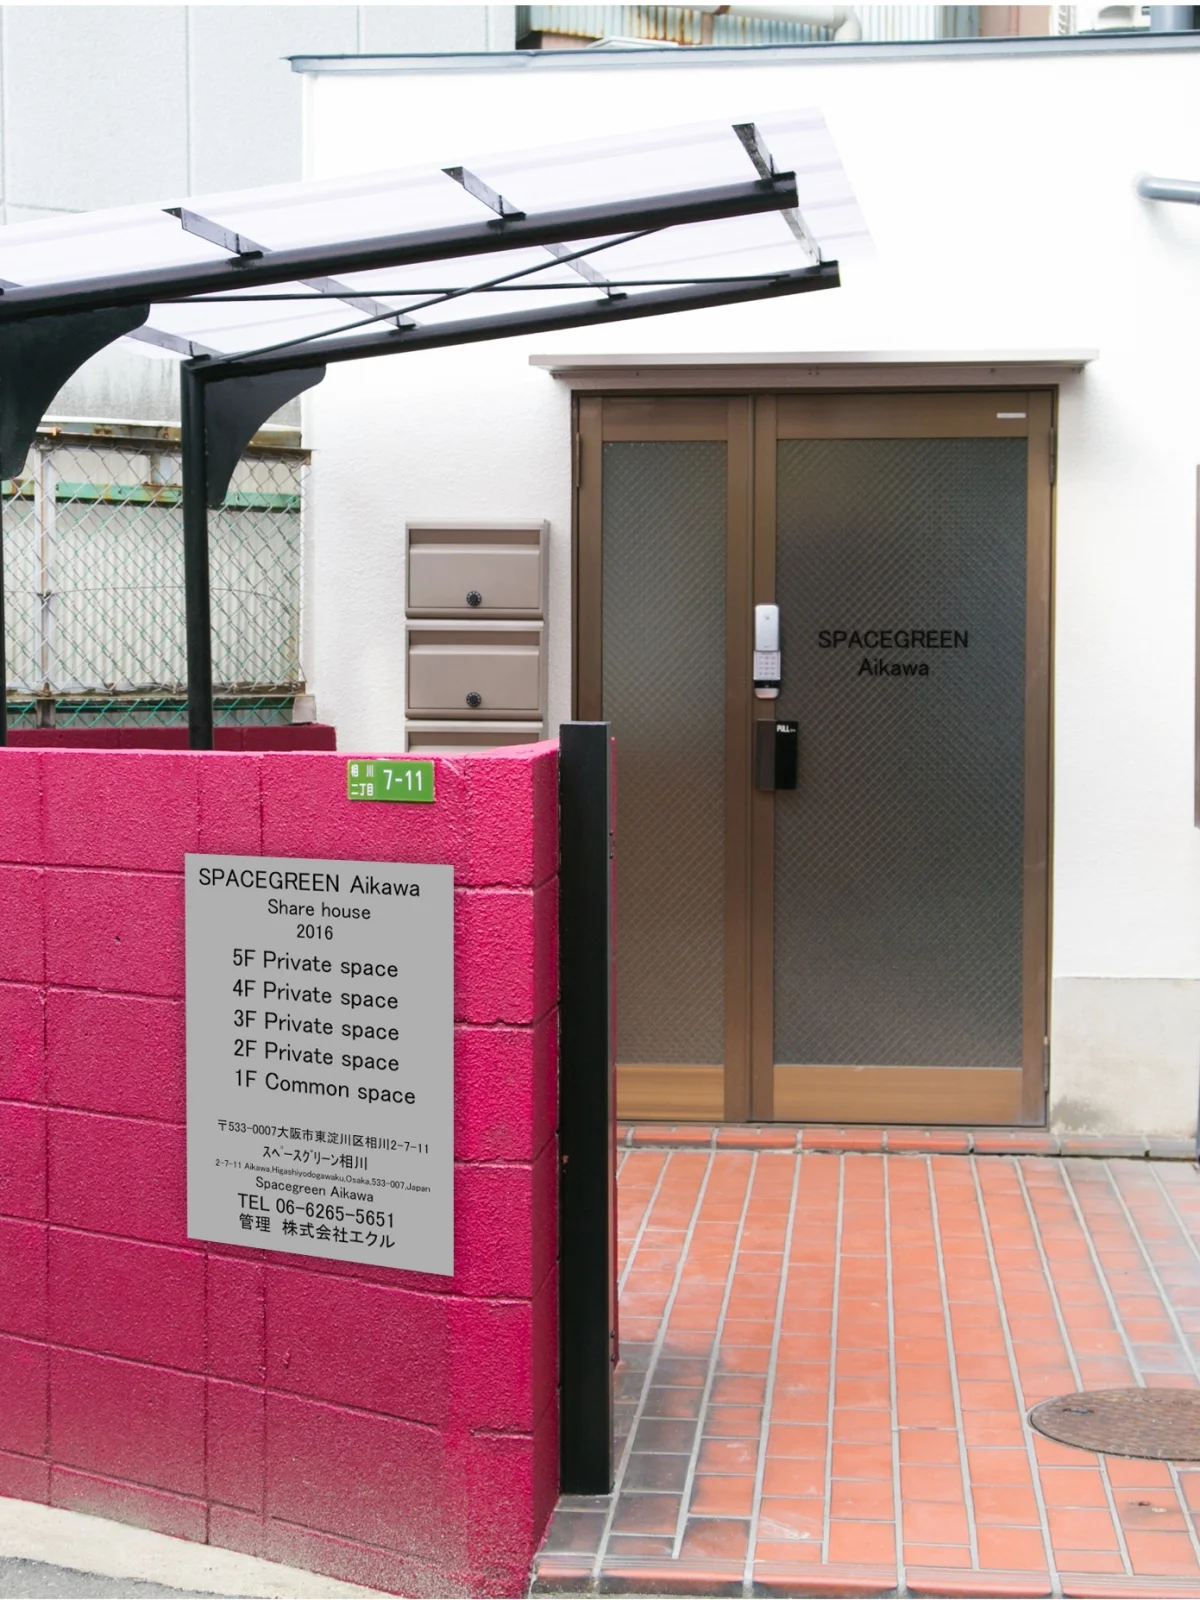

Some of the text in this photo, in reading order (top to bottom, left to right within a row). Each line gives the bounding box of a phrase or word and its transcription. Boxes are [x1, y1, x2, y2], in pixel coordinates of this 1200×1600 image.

[818, 630, 969, 649] SPACEGREEN
[858, 658, 930, 677] Aikawa
[383, 769, 423, 791] 7-11
[198, 867, 421, 898] SPACEGREEN Aikawa
[267, 898, 371, 920] Share house
[296, 923, 334, 941] 2016
[232, 947, 399, 979] 5F Private space
[232, 978, 399, 1010] 4F Private space
[233, 1008, 400, 1041] 3F Private space
[233, 1038, 400, 1072] 2F Private space
[235, 1069, 416, 1105] 1F Common space
[215, 1158, 242, 1169] 2-7-11
[255, 1175, 374, 1203] Spacegreen Aikawa
[237, 1192, 394, 1229] TEL 06-6265-5651
[238, 1212, 396, 1249] 管理 株式会社エクル
